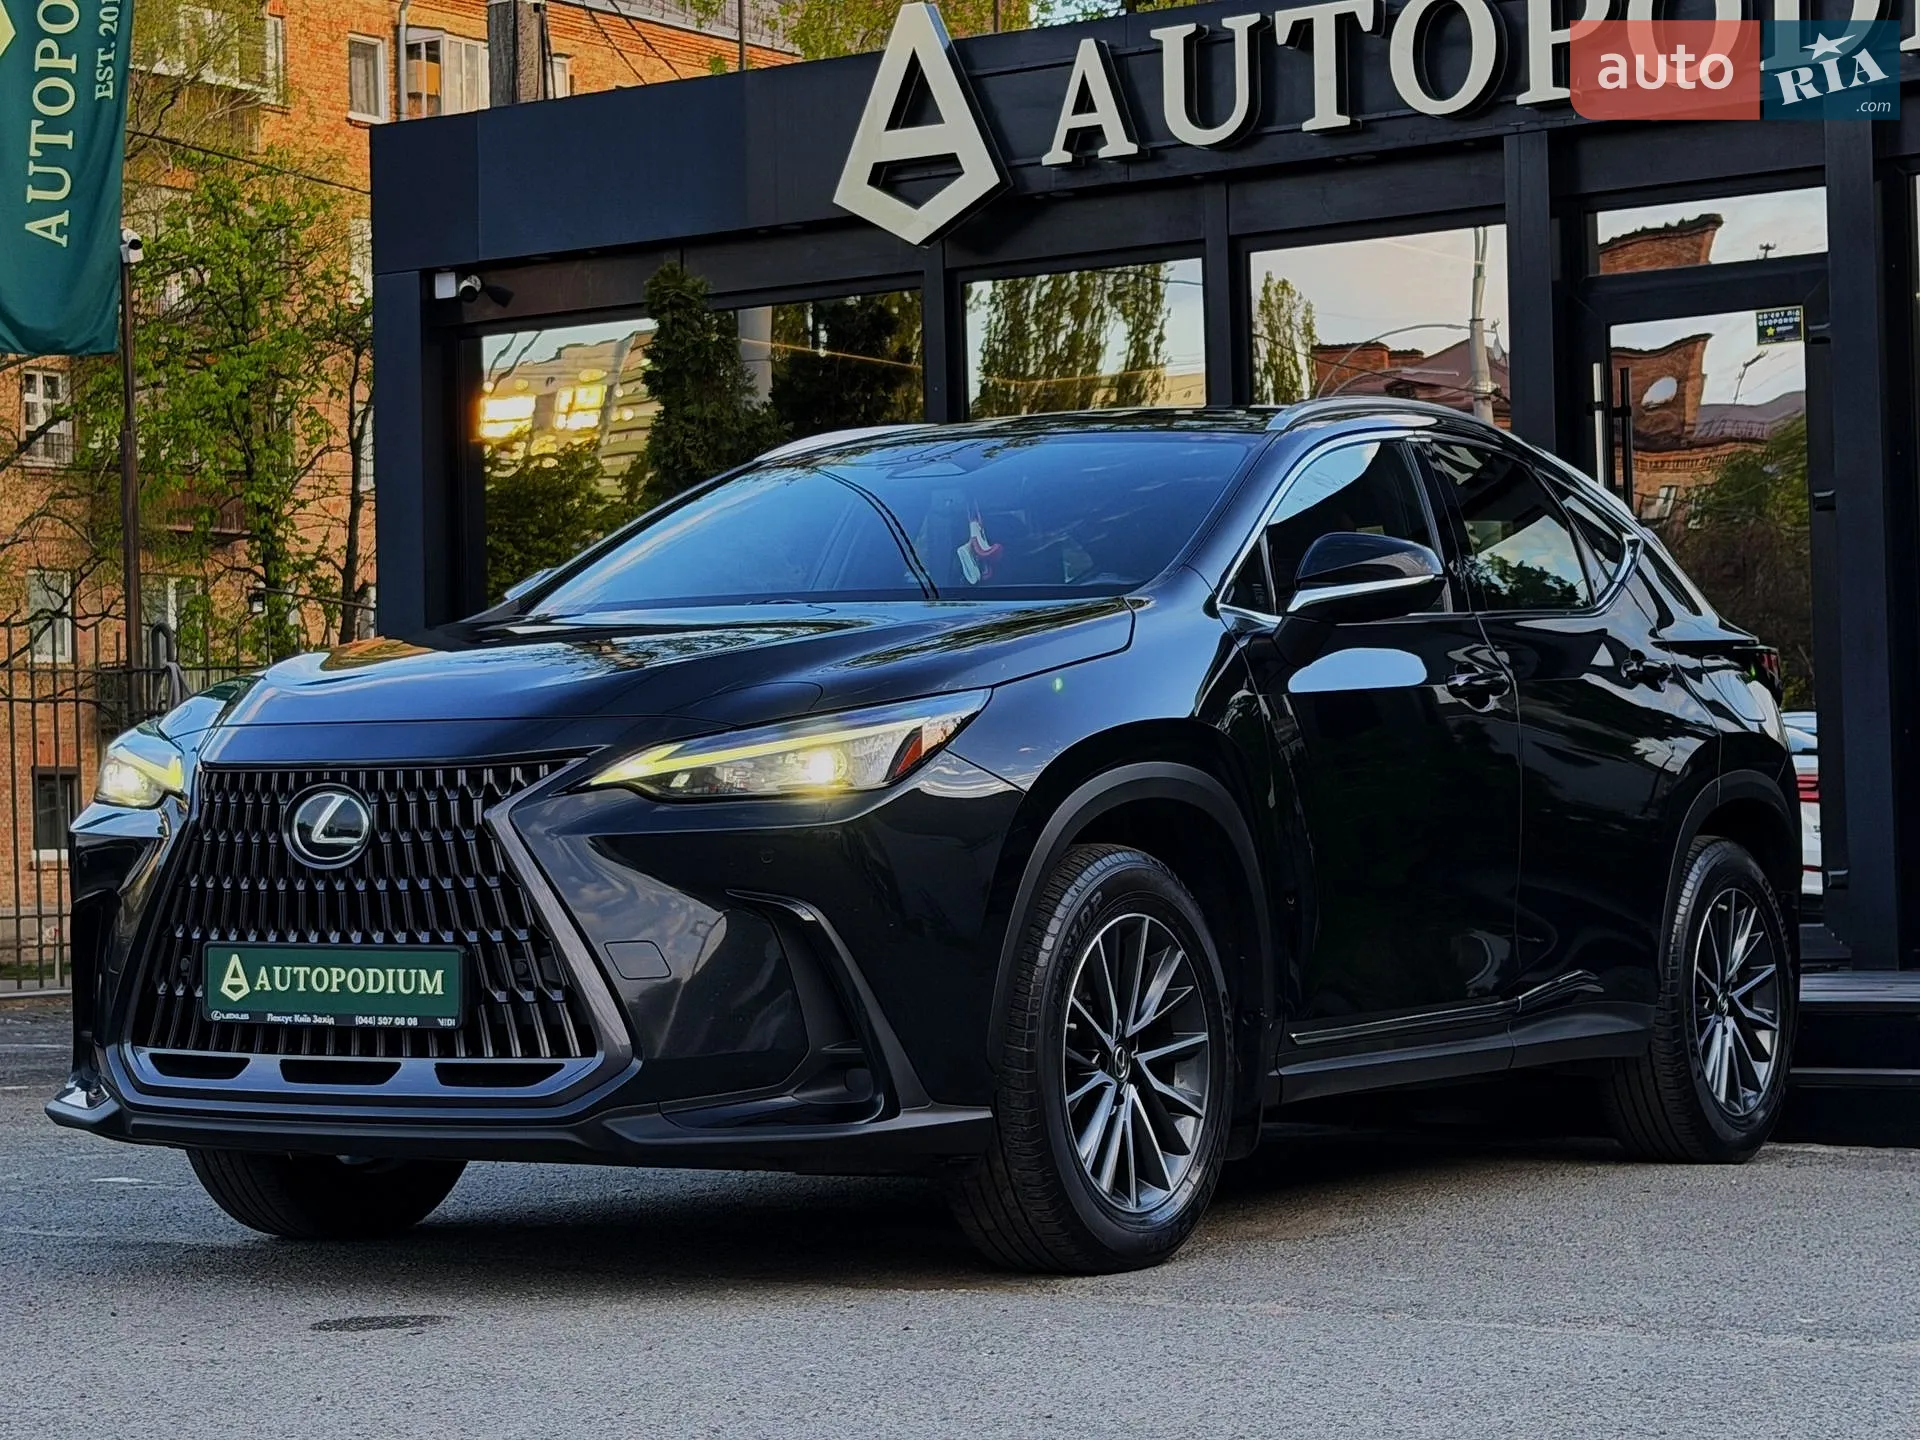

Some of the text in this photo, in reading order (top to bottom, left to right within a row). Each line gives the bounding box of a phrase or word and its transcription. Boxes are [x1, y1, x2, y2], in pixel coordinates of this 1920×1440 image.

[94, 41, 117, 101] EST.
[1041, 0, 1920, 167] AUTOPOD
[254, 965, 445, 995] AUTOPODIUM
[377, 1017, 393, 1026] 507
[407, 1017, 418, 1026] 08
[437, 1018, 456, 1026] VIDI
